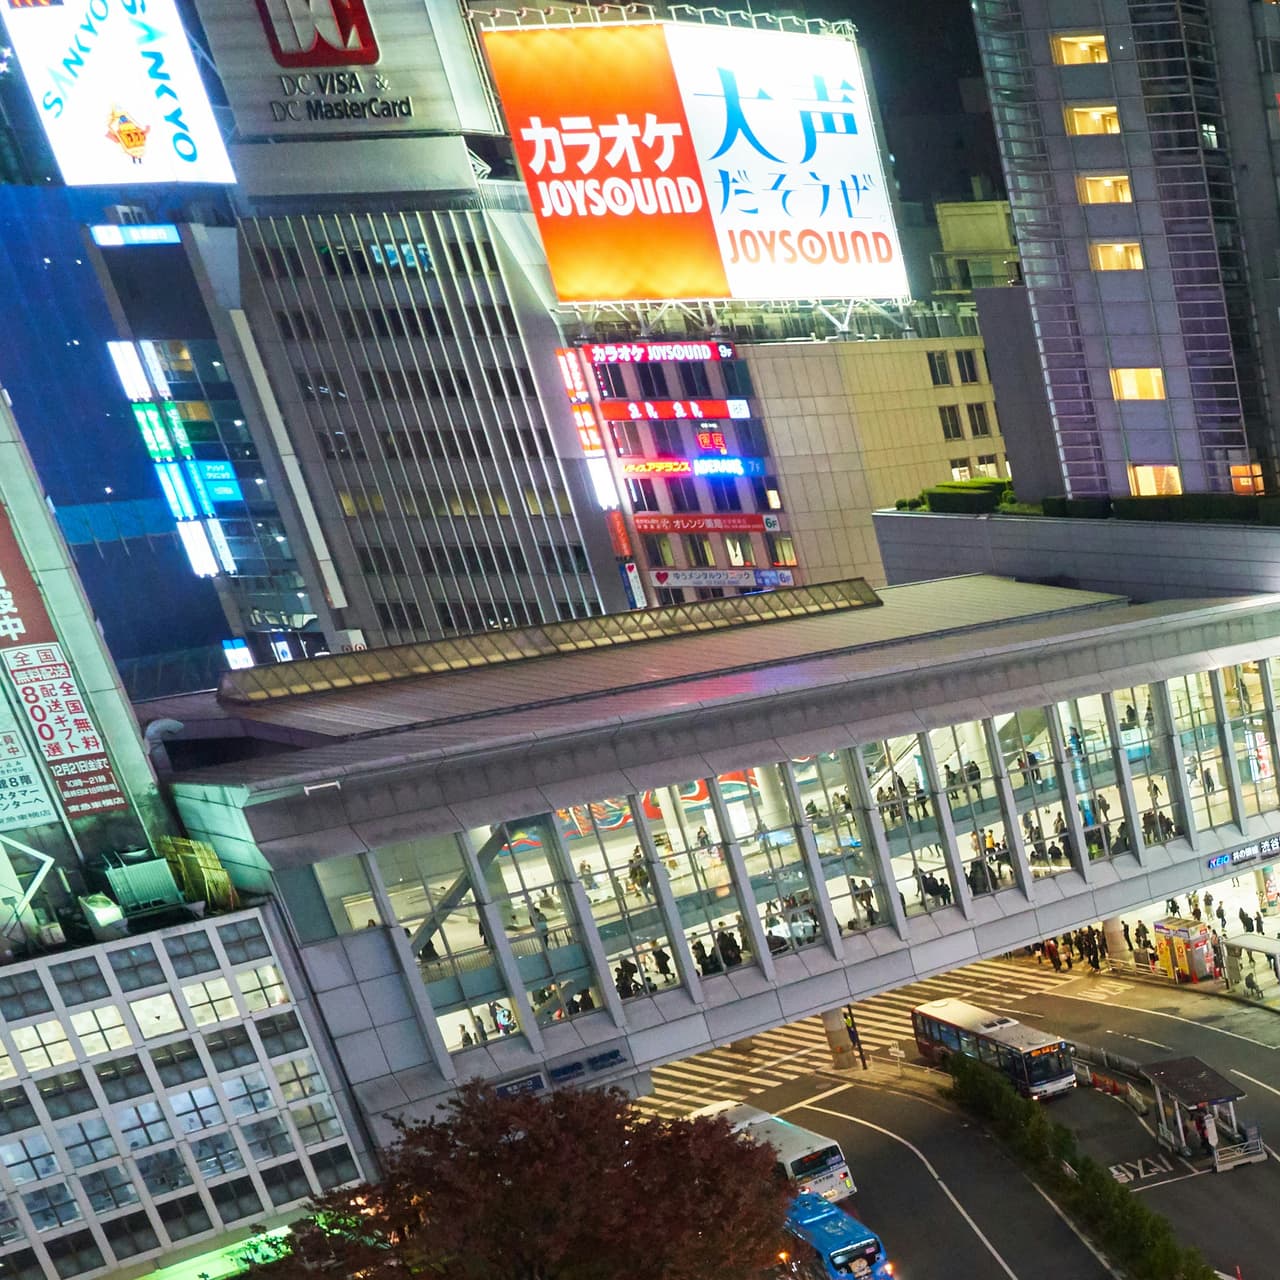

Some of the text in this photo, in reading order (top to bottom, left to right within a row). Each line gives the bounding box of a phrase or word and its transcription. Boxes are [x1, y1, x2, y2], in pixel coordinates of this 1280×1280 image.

[315, 71, 366, 96] VISA
[306, 96, 415, 121] MasterCard
[693, 67, 860, 165] 大声
[520, 113, 684, 175] カラオケ
[539, 176, 703, 218] JOYSOUND
[716, 168, 876, 220] だそうぜ
[728, 228, 893, 265] JOYSOUND
[592, 344, 644, 362] カラオケ
[647, 344, 712, 361] JOYSOUND
[765, 516, 778, 529] 6F
[13, 649, 56, 667] 全国
[40, 684, 80, 754] 配送ギフト
[59, 681, 100, 751] 全国無料
[1209, 855, 1230, 869] KEIO
